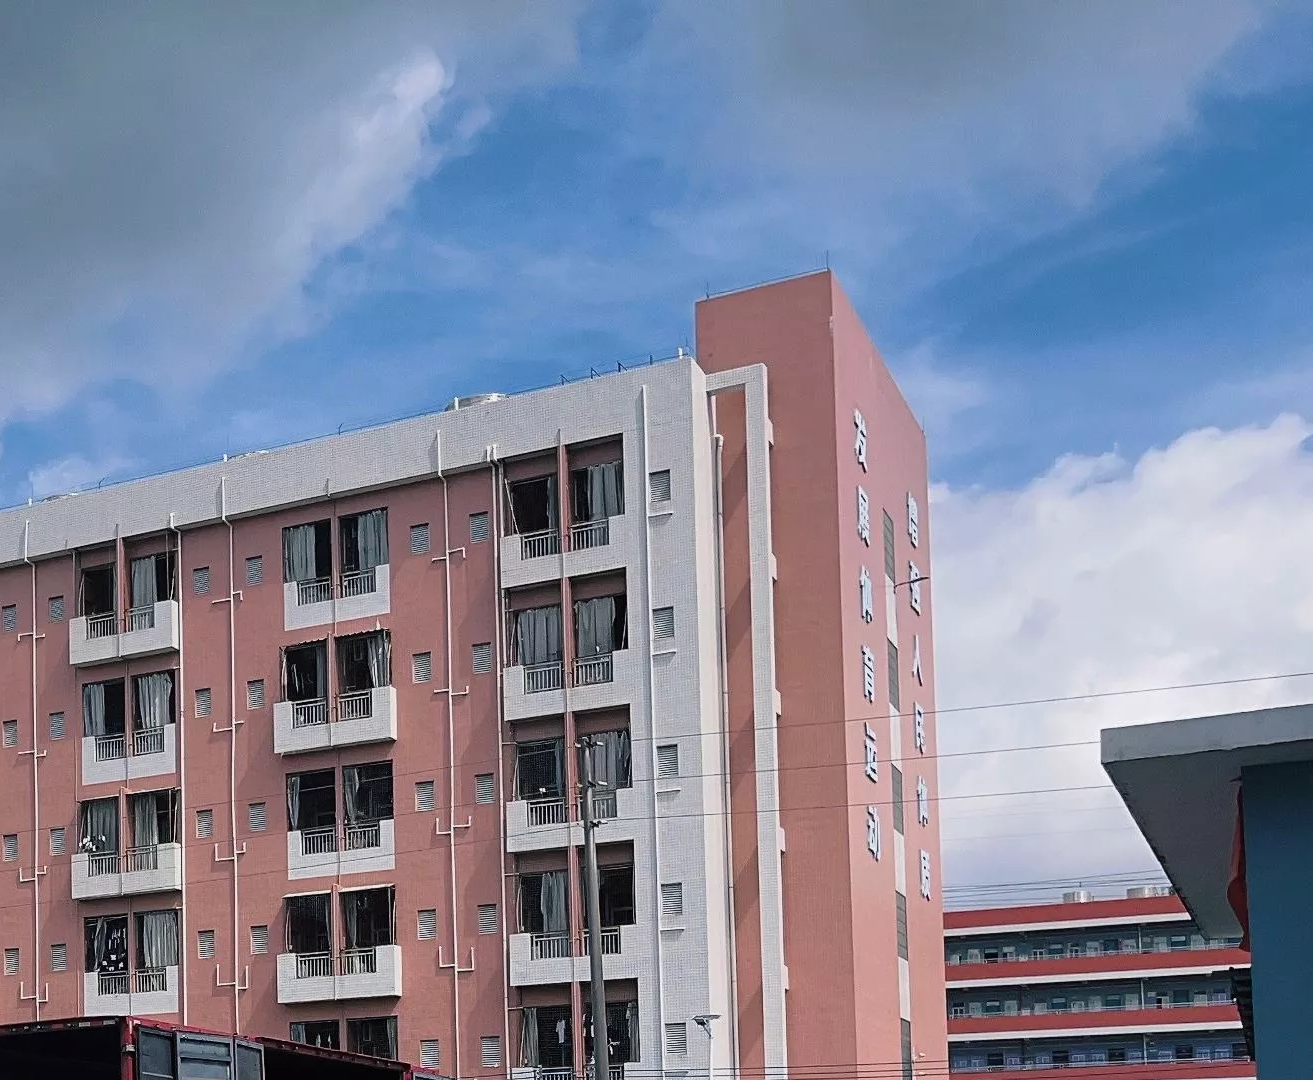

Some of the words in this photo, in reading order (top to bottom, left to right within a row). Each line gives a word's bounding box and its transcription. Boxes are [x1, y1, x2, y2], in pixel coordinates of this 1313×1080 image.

[853, 408, 881, 861] 发展体育运动
[906, 491, 931, 904] 增强人民体质
